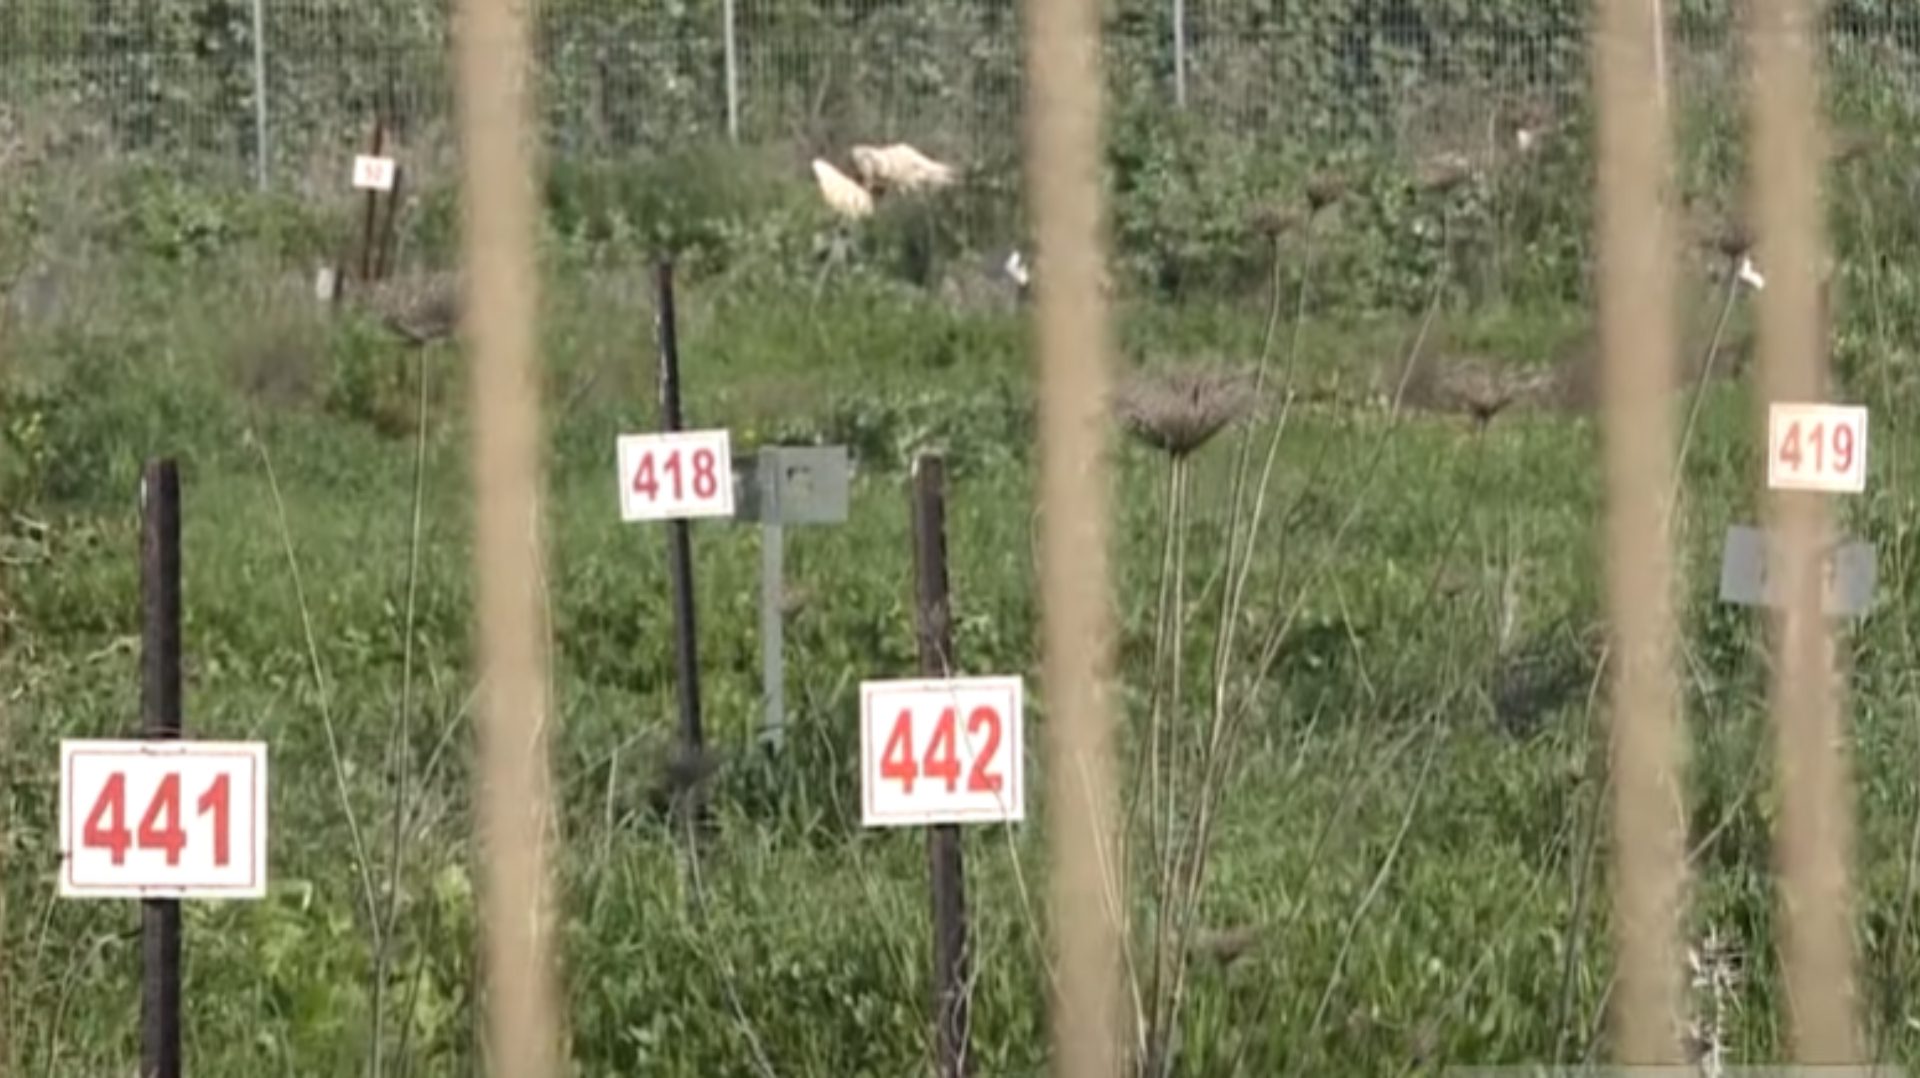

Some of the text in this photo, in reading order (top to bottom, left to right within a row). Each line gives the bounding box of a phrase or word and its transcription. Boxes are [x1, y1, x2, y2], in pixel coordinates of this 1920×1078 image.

[632, 449, 717, 501] 418
[1779, 420, 1854, 473] 419
[879, 704, 1004, 794] 442
[81, 771, 231, 867] 441
